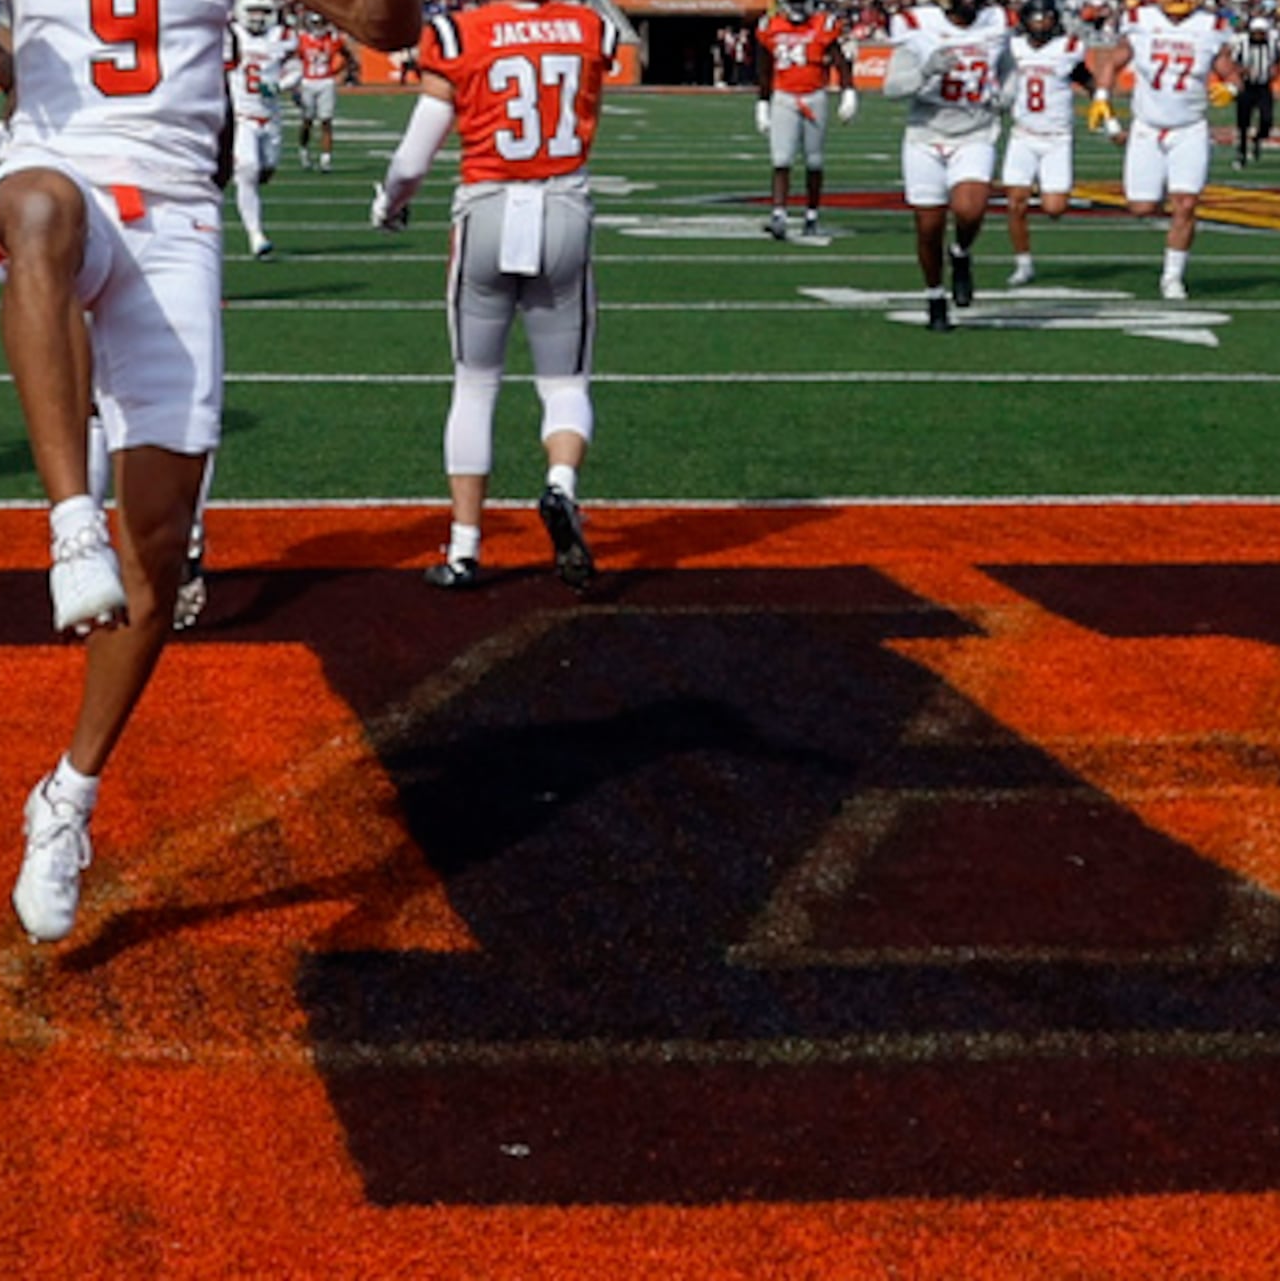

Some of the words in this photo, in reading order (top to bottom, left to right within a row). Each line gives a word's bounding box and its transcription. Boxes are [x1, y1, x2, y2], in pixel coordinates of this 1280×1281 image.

[490, 19, 584, 48] JACKSON
[1150, 53, 1195, 92] 77
[487, 53, 584, 160] 37
[1026, 77, 1046, 113] 8
